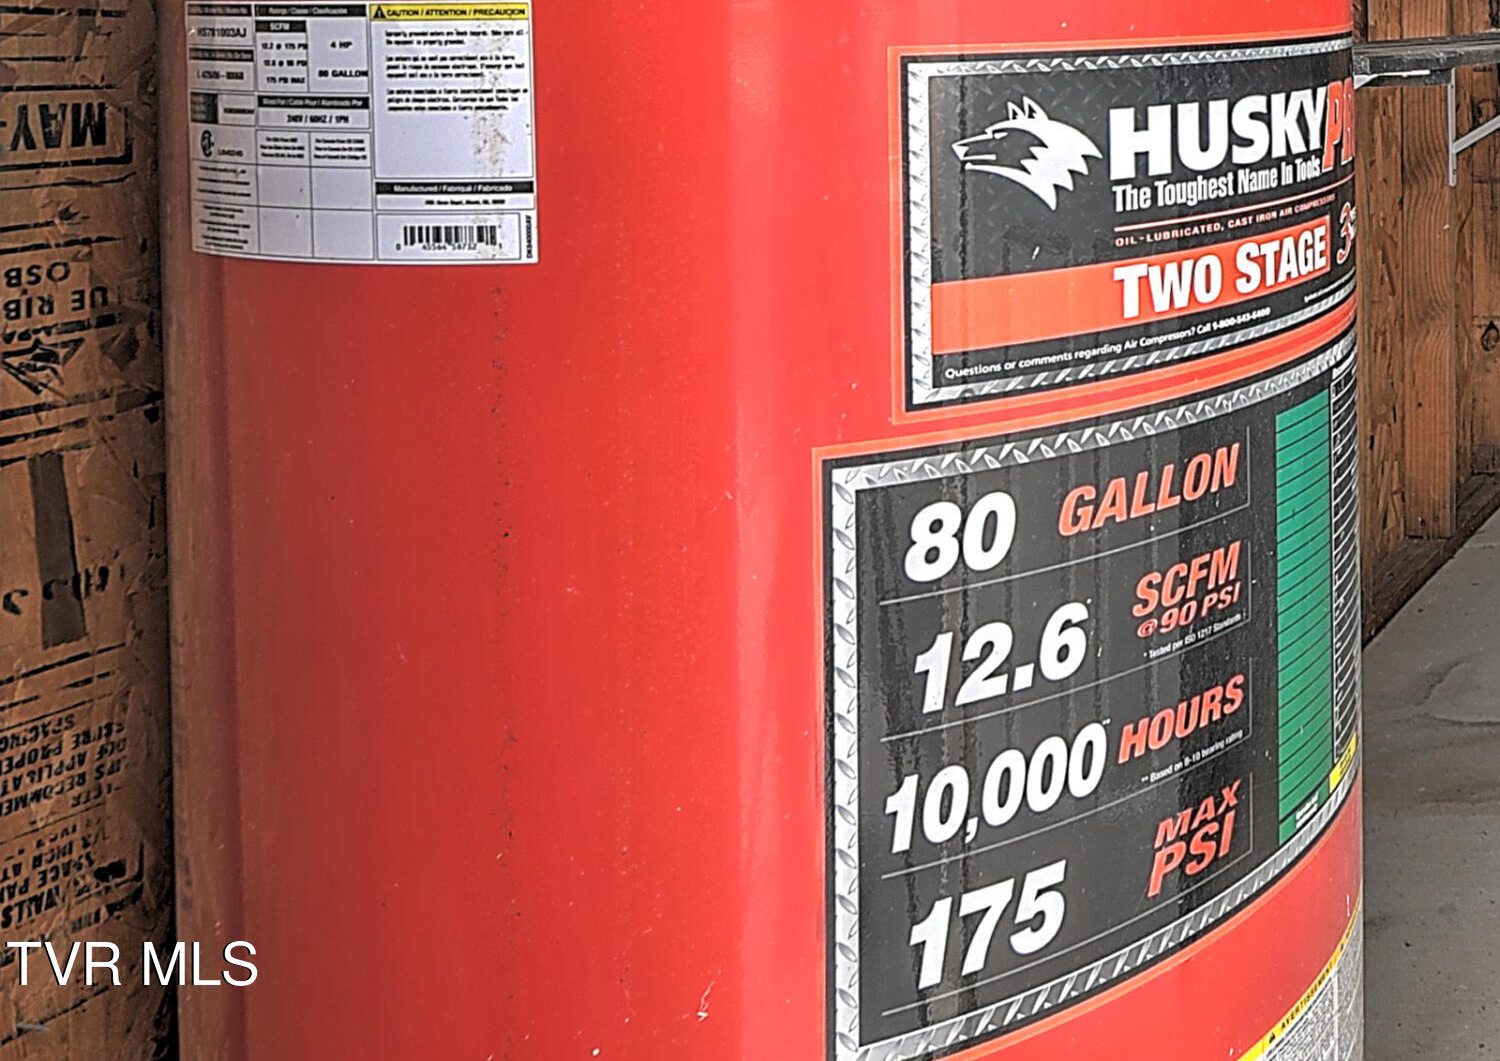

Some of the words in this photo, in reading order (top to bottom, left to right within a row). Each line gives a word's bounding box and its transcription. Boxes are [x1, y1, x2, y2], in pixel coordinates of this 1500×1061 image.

[270, 23, 290, 31] SCFM
[386, 9, 418, 17] CAUTION
[331, 70, 368, 78] GALLON
[1112, 183, 1151, 213] The
[1154, 175, 1235, 208] Toughest
[1237, 166, 1278, 195] Name
[1281, 161, 1294, 186] In
[1296, 155, 1321, 181] Tools
[1228, 215, 1253, 228] CAST
[1256, 211, 1277, 223] IRON
[1280, 207, 1293, 218] AIR
[3, 261, 71, 288] OSB
[1113, 254, 1223, 319] TWO
[1235, 225, 1328, 294] STAGE
[945, 361, 1002, 379] Questions
[1003, 361, 1016, 370] or
[1018, 352, 1073, 368] comments
[1074, 341, 1122, 359] regarding
[1124, 338, 1138, 350] Air
[1139, 326, 1196, 346] Compressors?
[1197, 322, 1212, 335] Call
[904, 491, 1017, 583] 80
[1058, 443, 1240, 537] GALLON
[1132, 540, 1242, 618] SCFM
[1201, 581, 1241, 618] PSI
[1149, 642, 1171, 658] Tested
[1172, 640, 1183, 651] per
[1184, 633, 1196, 645] ISO
[1197, 625, 1212, 639] 1217
[1118, 674, 1245, 764] HOURS
[1150, 764, 1173, 783] Based
[1174, 761, 1183, 772] on
[1201, 739, 1225, 759] bearing
[1225, 729, 1243, 745] rating
[0, 770, 87, 818] RECOMME
[1153, 778, 1242, 849] MAX
[909, 859, 1067, 990] 175
[1148, 809, 1236, 899] PSI
